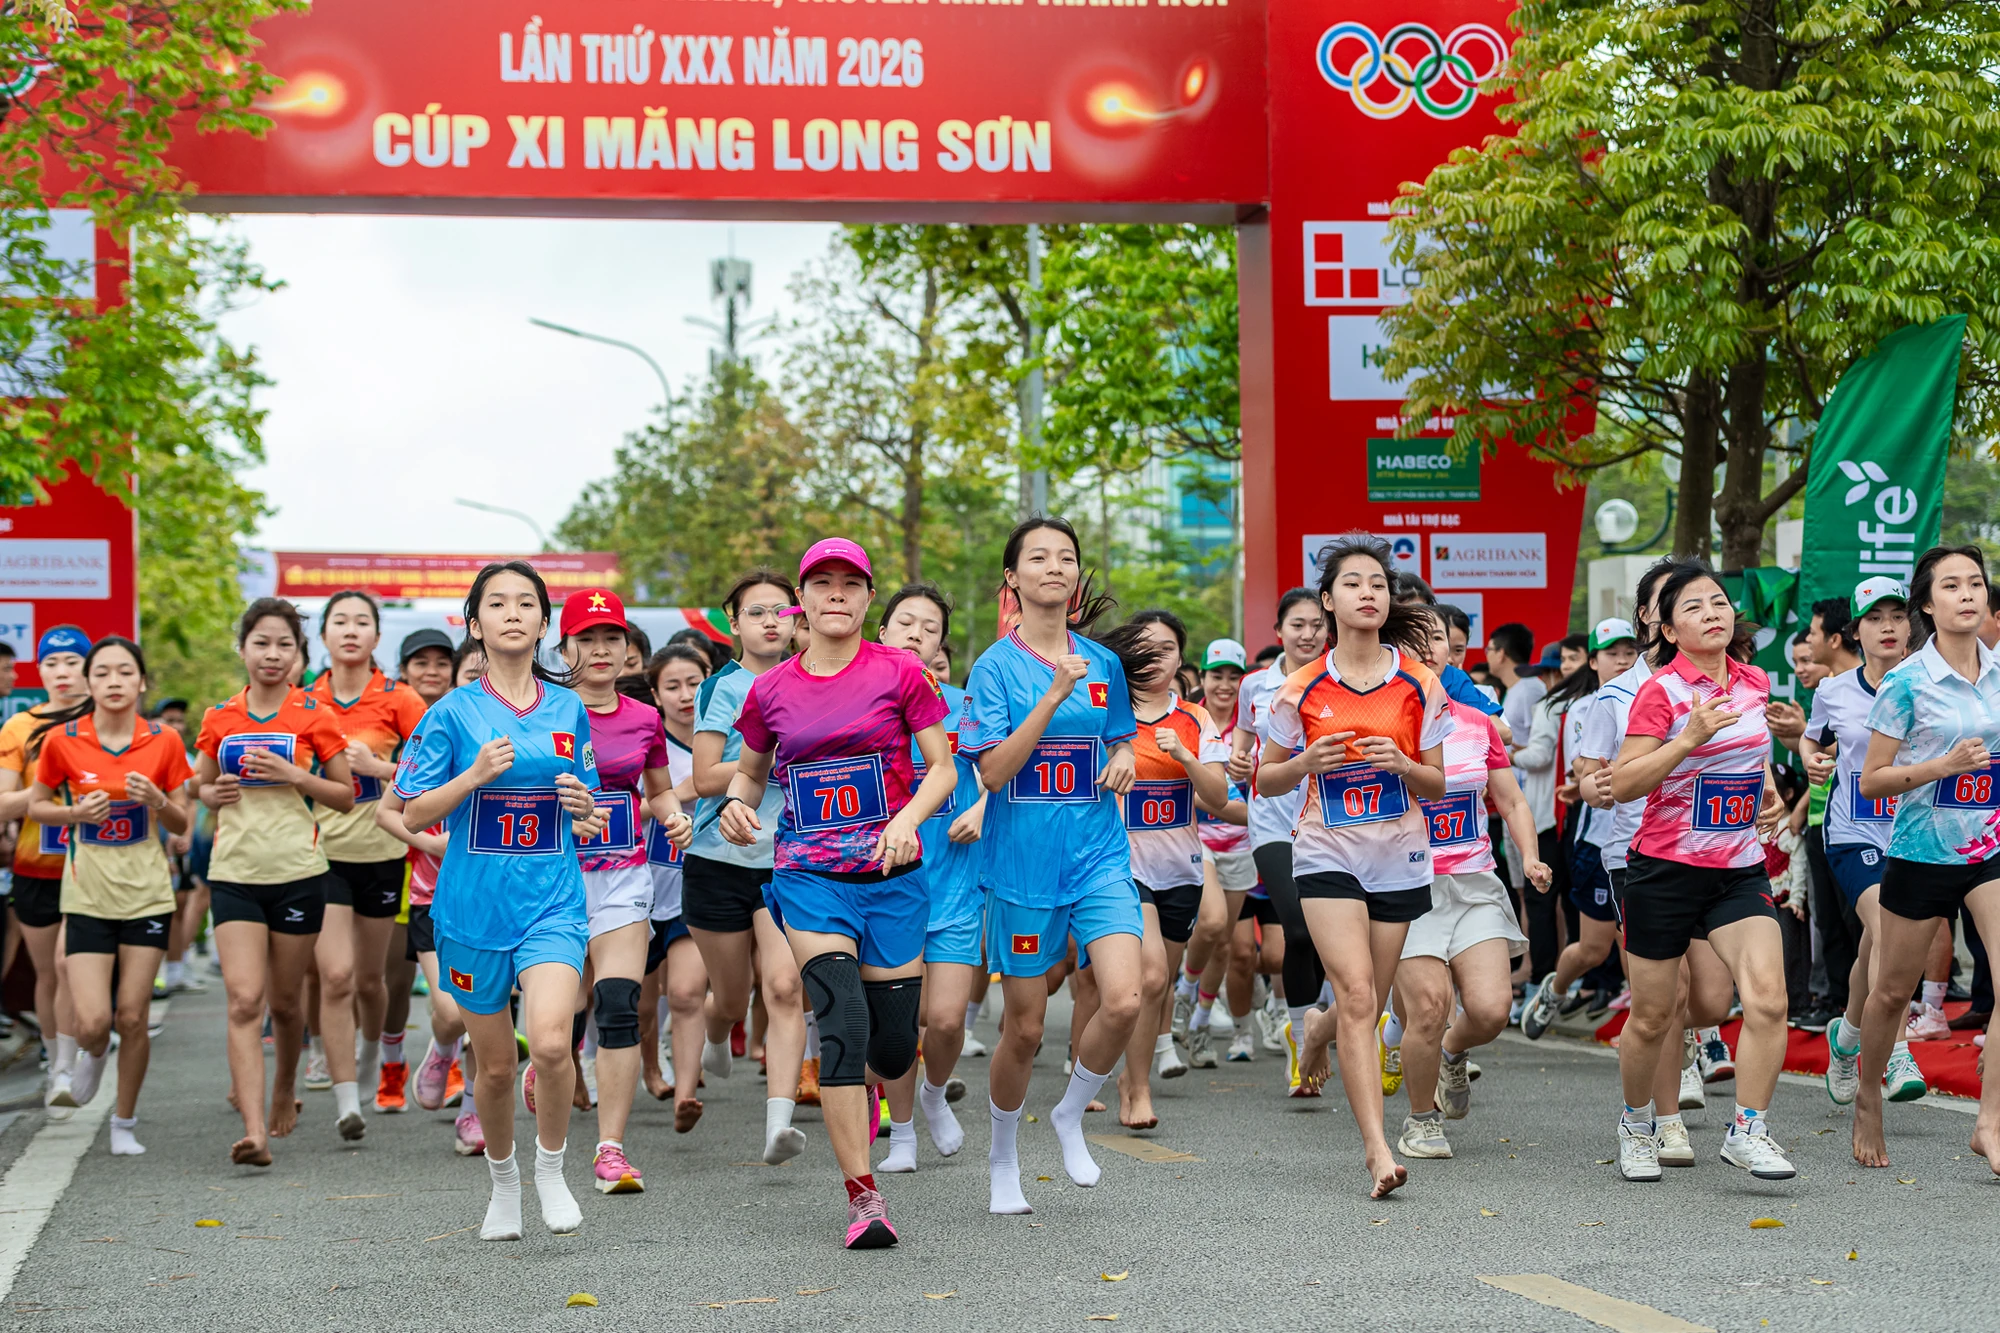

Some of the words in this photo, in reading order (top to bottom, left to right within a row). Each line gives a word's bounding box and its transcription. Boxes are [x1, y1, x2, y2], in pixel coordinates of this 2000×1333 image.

[499, 17, 572, 83] LẦN
[580, 23, 656, 85] THỨ
[660, 34, 734, 86] XXX
[743, 26, 828, 87] NĂM
[837, 38, 925, 88] 2026
[373, 103, 491, 168] CÚP
[507, 114, 565, 169] XI
[583, 106, 755, 171] MĂNG
[772, 118, 920, 172] LONG
[936, 115, 1052, 173] SƠN
[1376, 455, 1452, 469] HABECO
[1383, 512, 1404, 526] NHÀ
[4, 555, 104, 570] AGRIBANK
[1453, 547, 1542, 561] AGRIBANK
[1035, 761, 1075, 794] 10
[1955, 773, 1993, 803] 68
[814, 785, 861, 820] 70
[1142, 799, 1176, 825] 09
[1343, 783, 1383, 817] 07
[1707, 794, 1755, 825] 136
[97, 818, 132, 841] 29
[498, 813, 540, 847] 13
